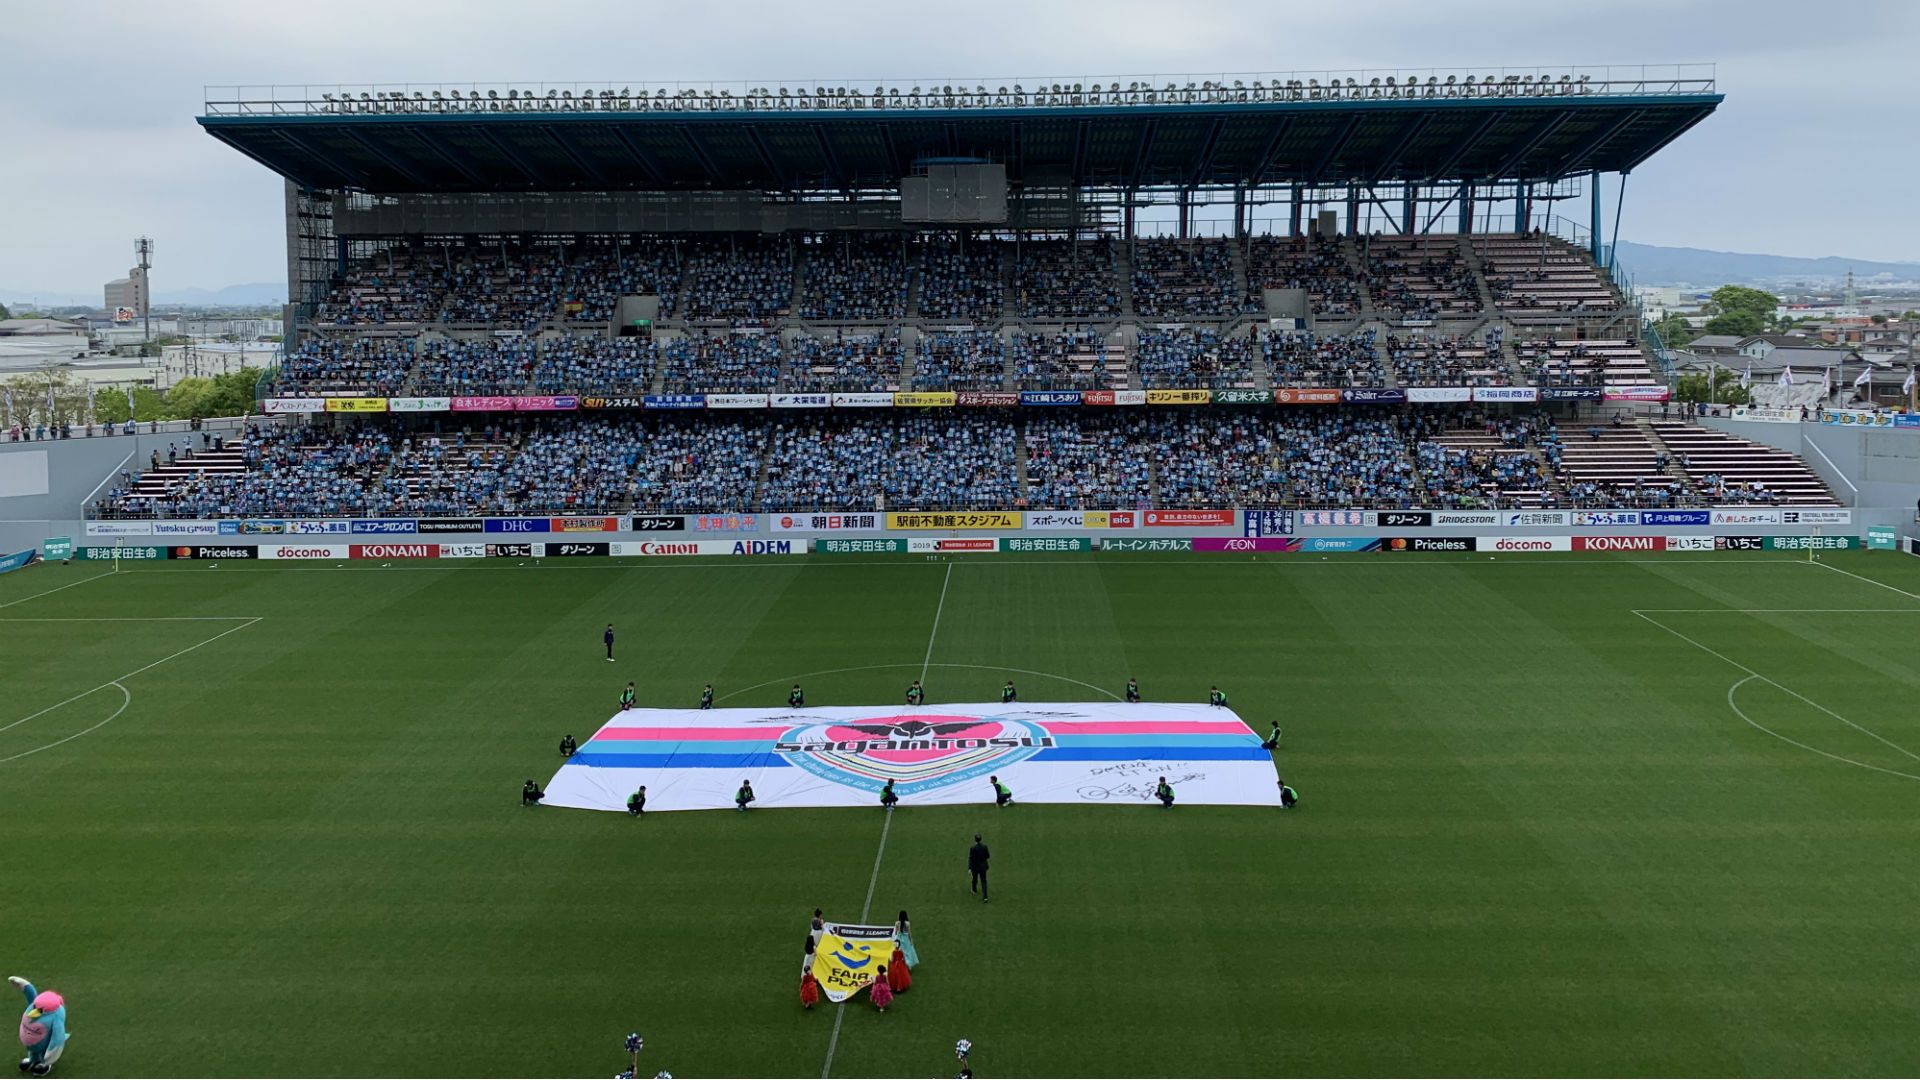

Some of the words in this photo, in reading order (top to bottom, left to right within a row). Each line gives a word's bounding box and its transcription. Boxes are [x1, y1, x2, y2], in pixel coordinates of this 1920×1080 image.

[1088, 392, 1113, 403] FUJITSU
[1119, 391, 1144, 402] FUJITSU
[1149, 390, 1208, 401] キリン一番搾り
[1218, 391, 1269, 401] 久留米大学
[517, 398, 554, 407] クリニック
[605, 398, 639, 407] システム
[641, 518, 675, 529] ダゾーン
[811, 516, 875, 529] 朝日新聞
[896, 515, 1012, 527] 駅前不動産スタジアム
[1031, 514, 1083, 525] スポーツくじ
[1387, 514, 1422, 525] ダゾーン
[1438, 515, 1496, 524] BRIDGESTONE
[1521, 514, 1563, 525] 佐賀新聞
[154, 523, 186, 534] Yutoku
[187, 523, 216, 535] Group
[364, 522, 415, 532] エアーサロンパス
[502, 520, 532, 531] DHC
[640, 541, 698, 555] Canon
[732, 540, 791, 555] AiDEM
[826, 540, 897, 552] 明治安田生命
[1009, 539, 1080, 551] 明治安田生命
[1496, 538, 1552, 550] docomo
[1585, 537, 1653, 550] KONAMI
[1679, 538, 1713, 549] いちご
[1726, 538, 1762, 549] いちご
[1774, 537, 1849, 549] 明治安田生命
[87, 547, 157, 559] 明治安田生命
[277, 546, 331, 558] docomo
[361, 545, 427, 557] KONAMI
[451, 546, 485, 557] いちご
[497, 545, 531, 557] いちご
[560, 544, 595, 555] ダゾーン
[831, 967, 870, 981] FAIR
